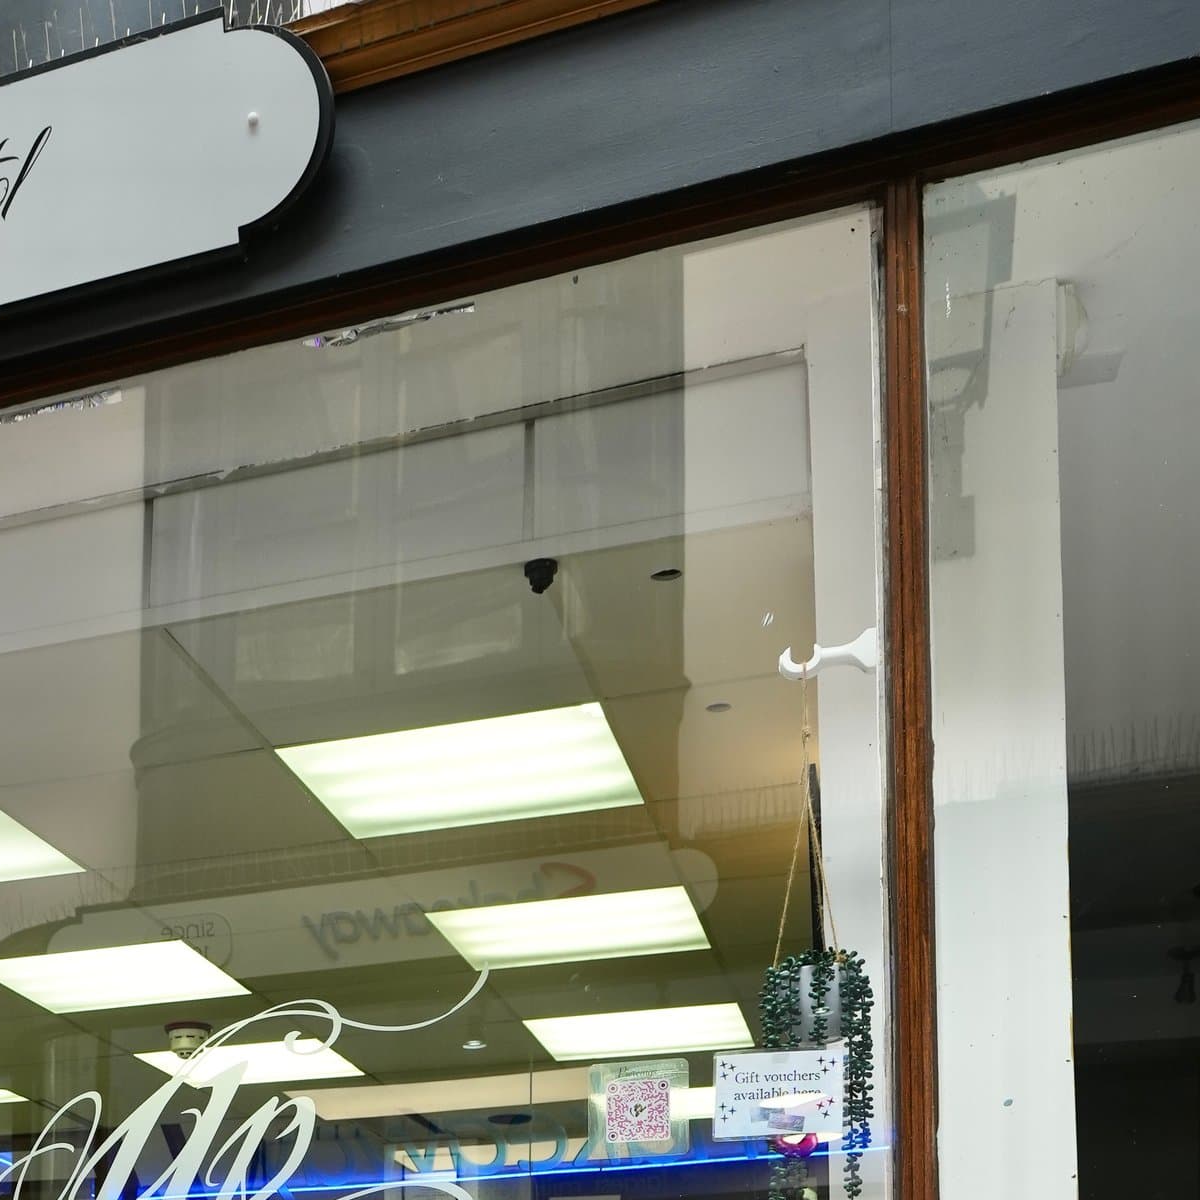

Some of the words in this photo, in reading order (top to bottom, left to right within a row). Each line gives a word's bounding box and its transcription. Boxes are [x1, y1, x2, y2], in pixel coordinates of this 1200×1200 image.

[735, 1072, 760, 1084] Gift
[764, 1070, 821, 1083] vouchers
[734, 1087, 789, 1102] available
